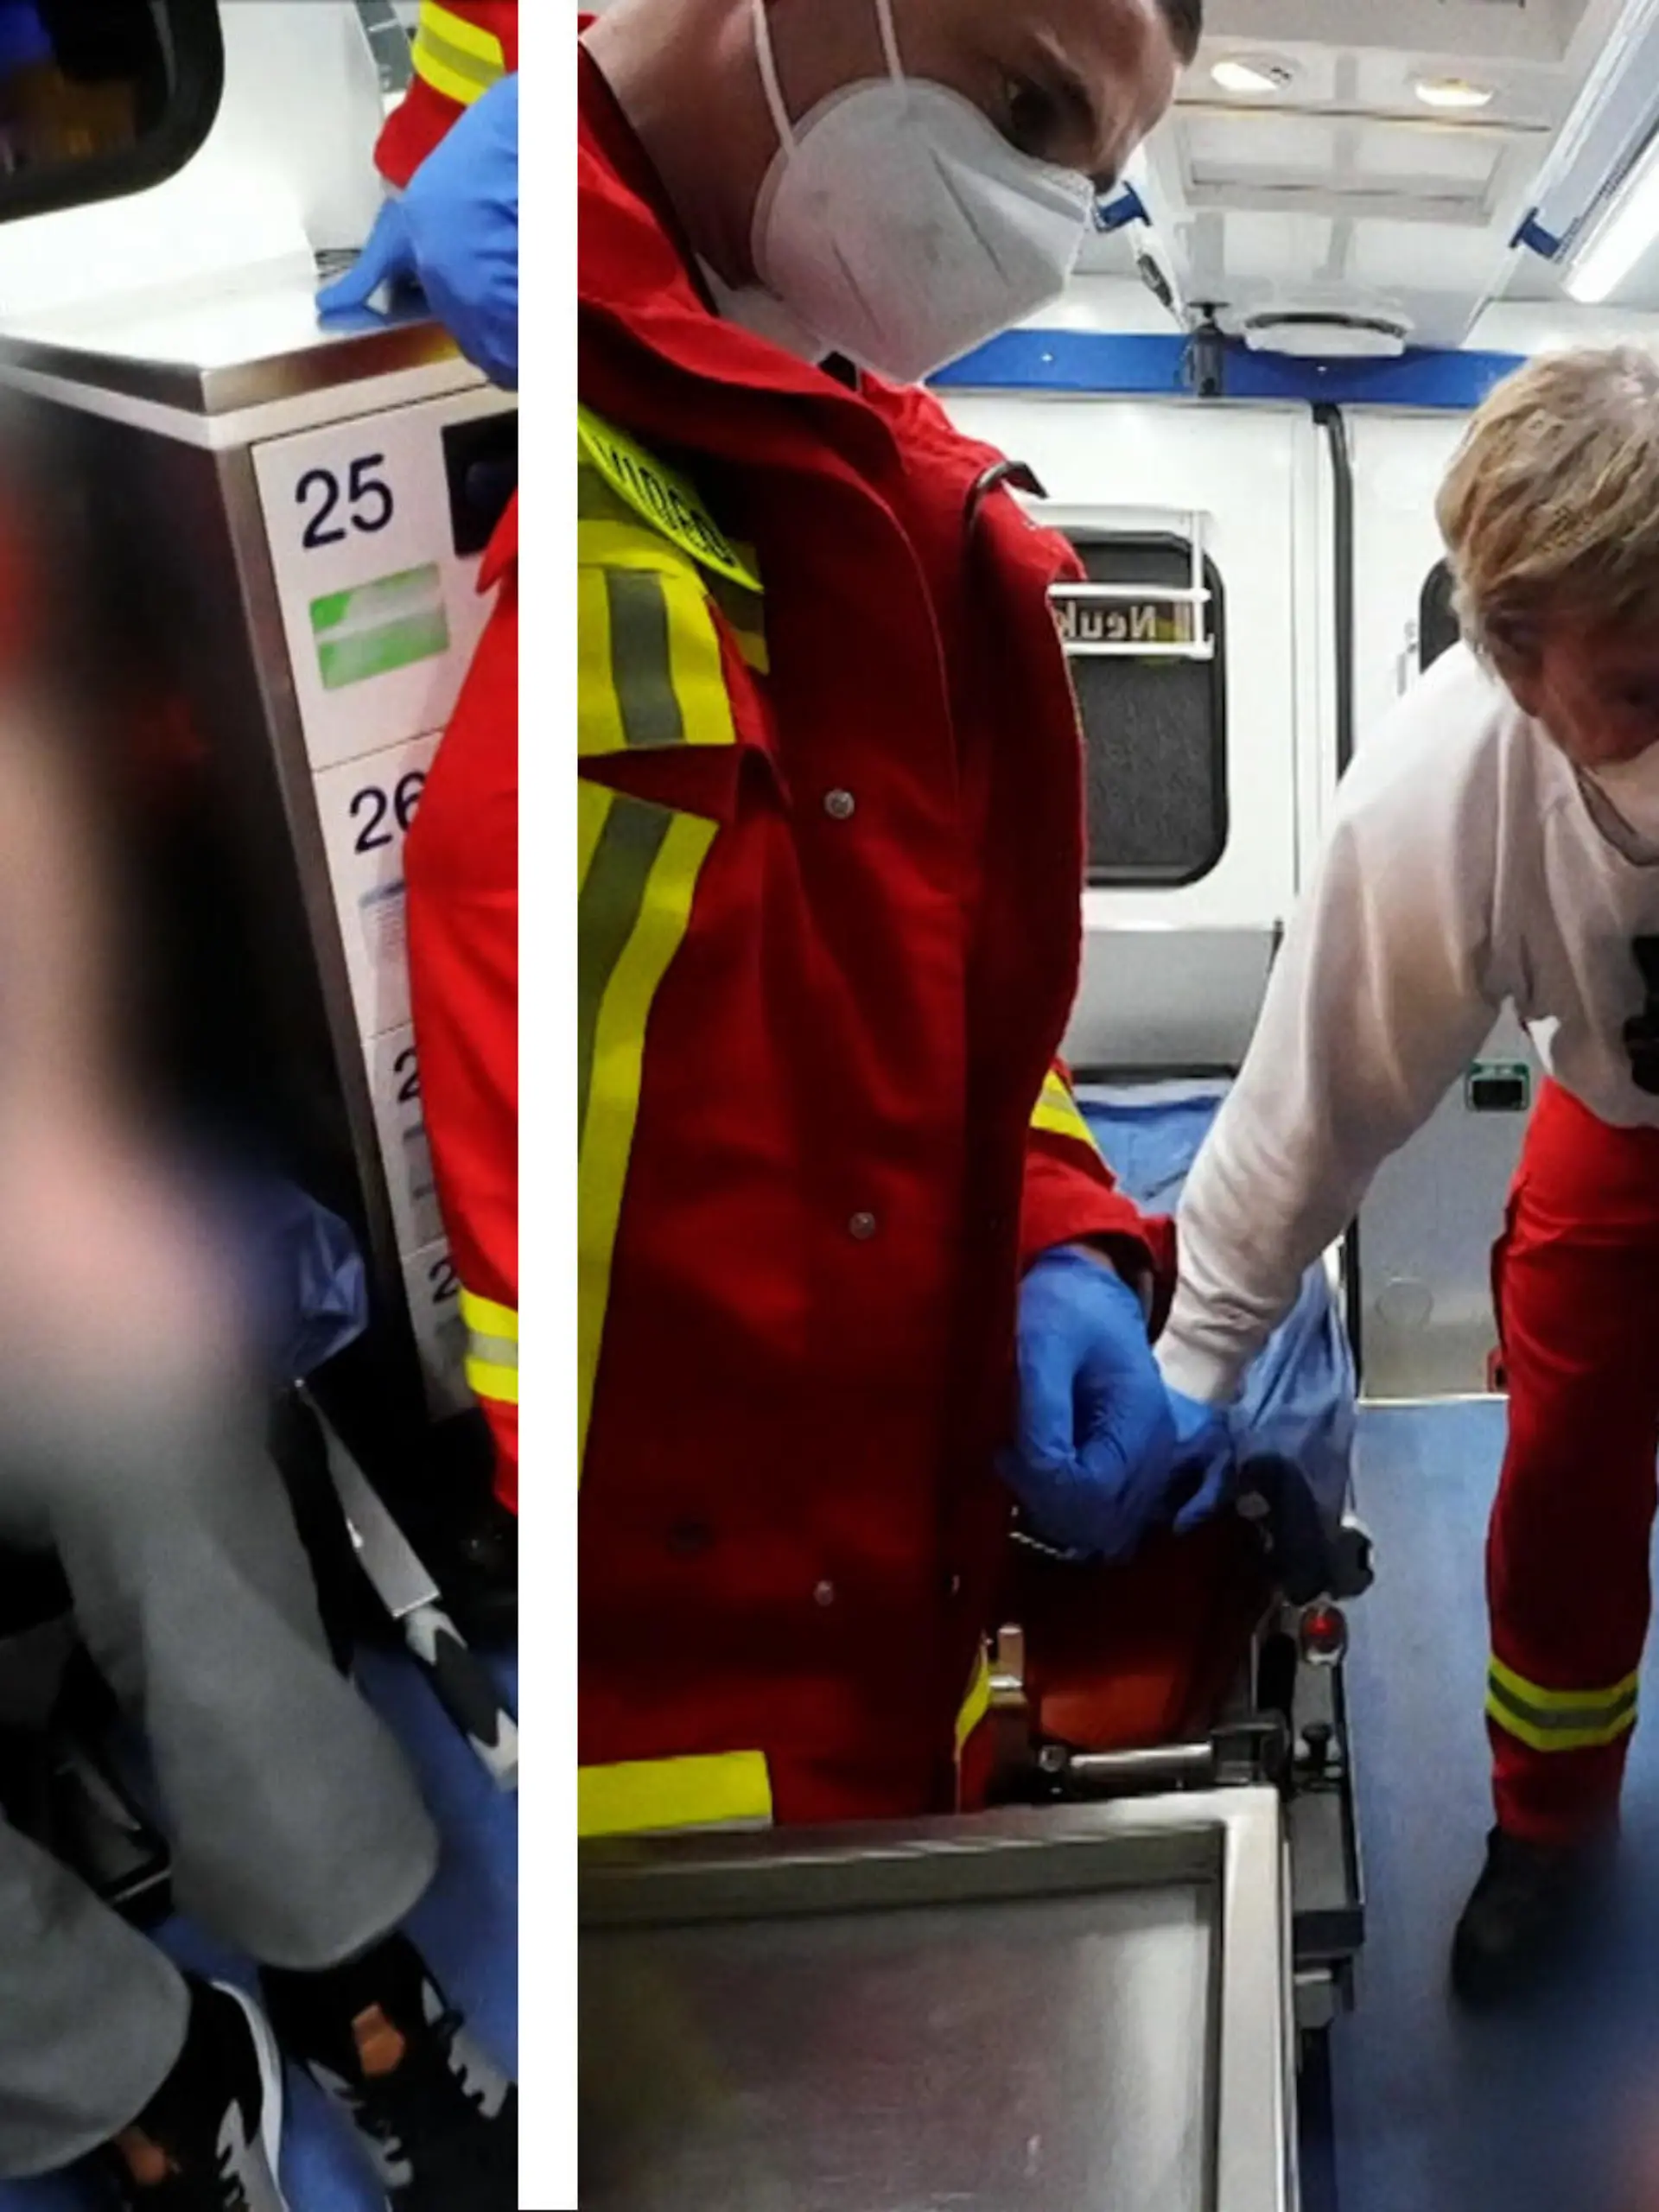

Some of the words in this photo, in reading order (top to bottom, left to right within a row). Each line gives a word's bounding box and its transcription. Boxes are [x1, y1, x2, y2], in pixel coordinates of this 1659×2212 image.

[295, 453, 394, 549] 25
[394, 1046, 422, 1103] 2
[429, 1257, 459, 1304] 2
